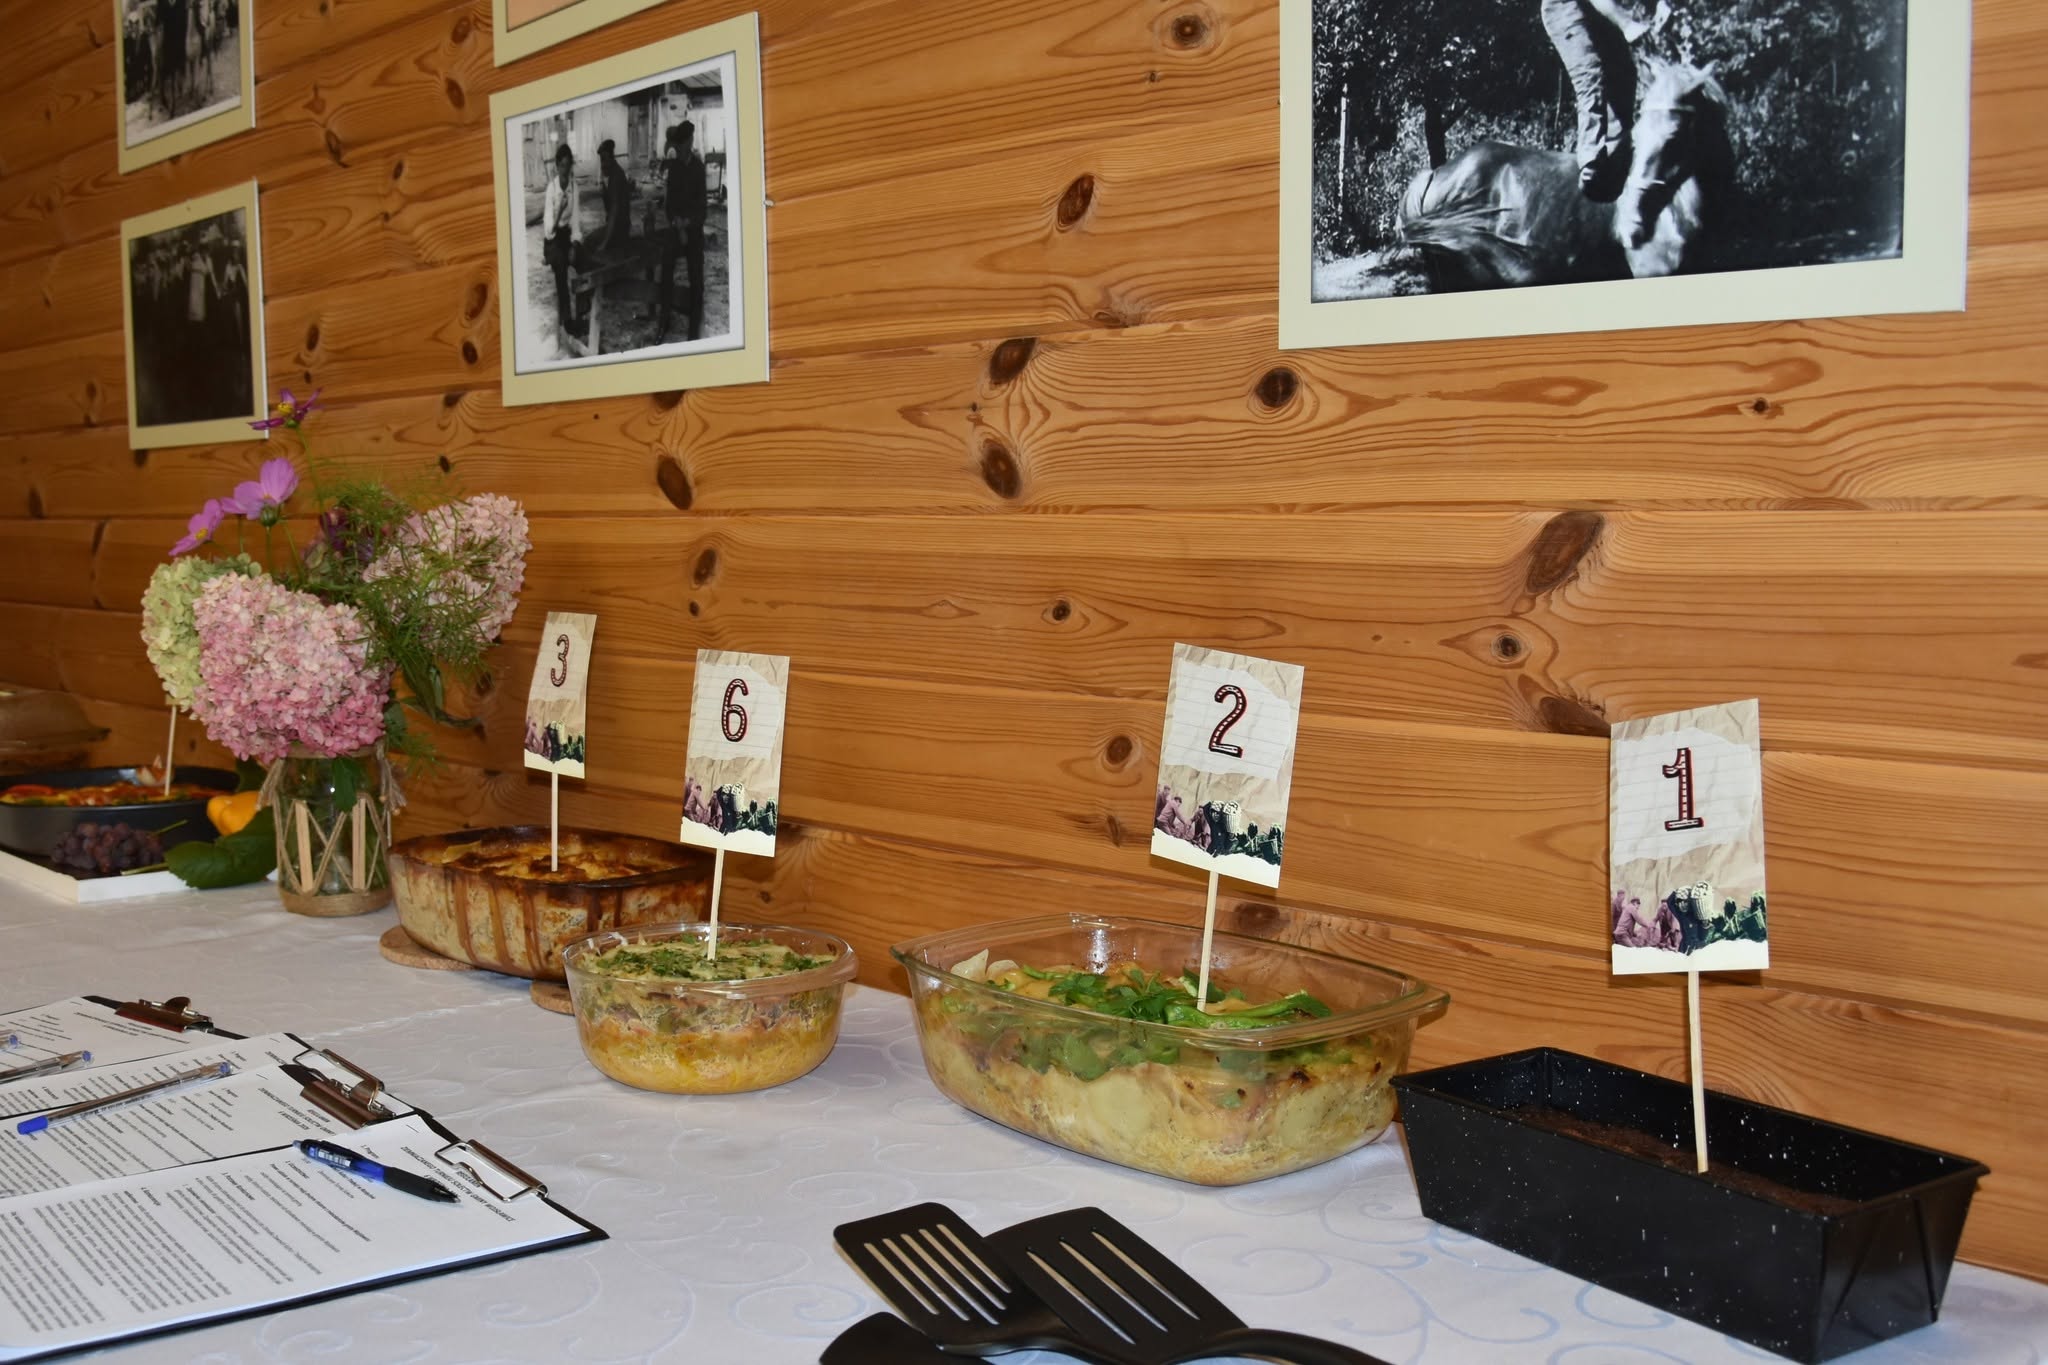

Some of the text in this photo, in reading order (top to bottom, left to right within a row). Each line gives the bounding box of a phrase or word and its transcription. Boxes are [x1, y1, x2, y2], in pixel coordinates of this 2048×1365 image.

[551, 634, 570, 687] 3
[722, 678, 749, 742] 6
[1208, 684, 1248, 759] 2
[1662, 747, 1704, 832] 1
